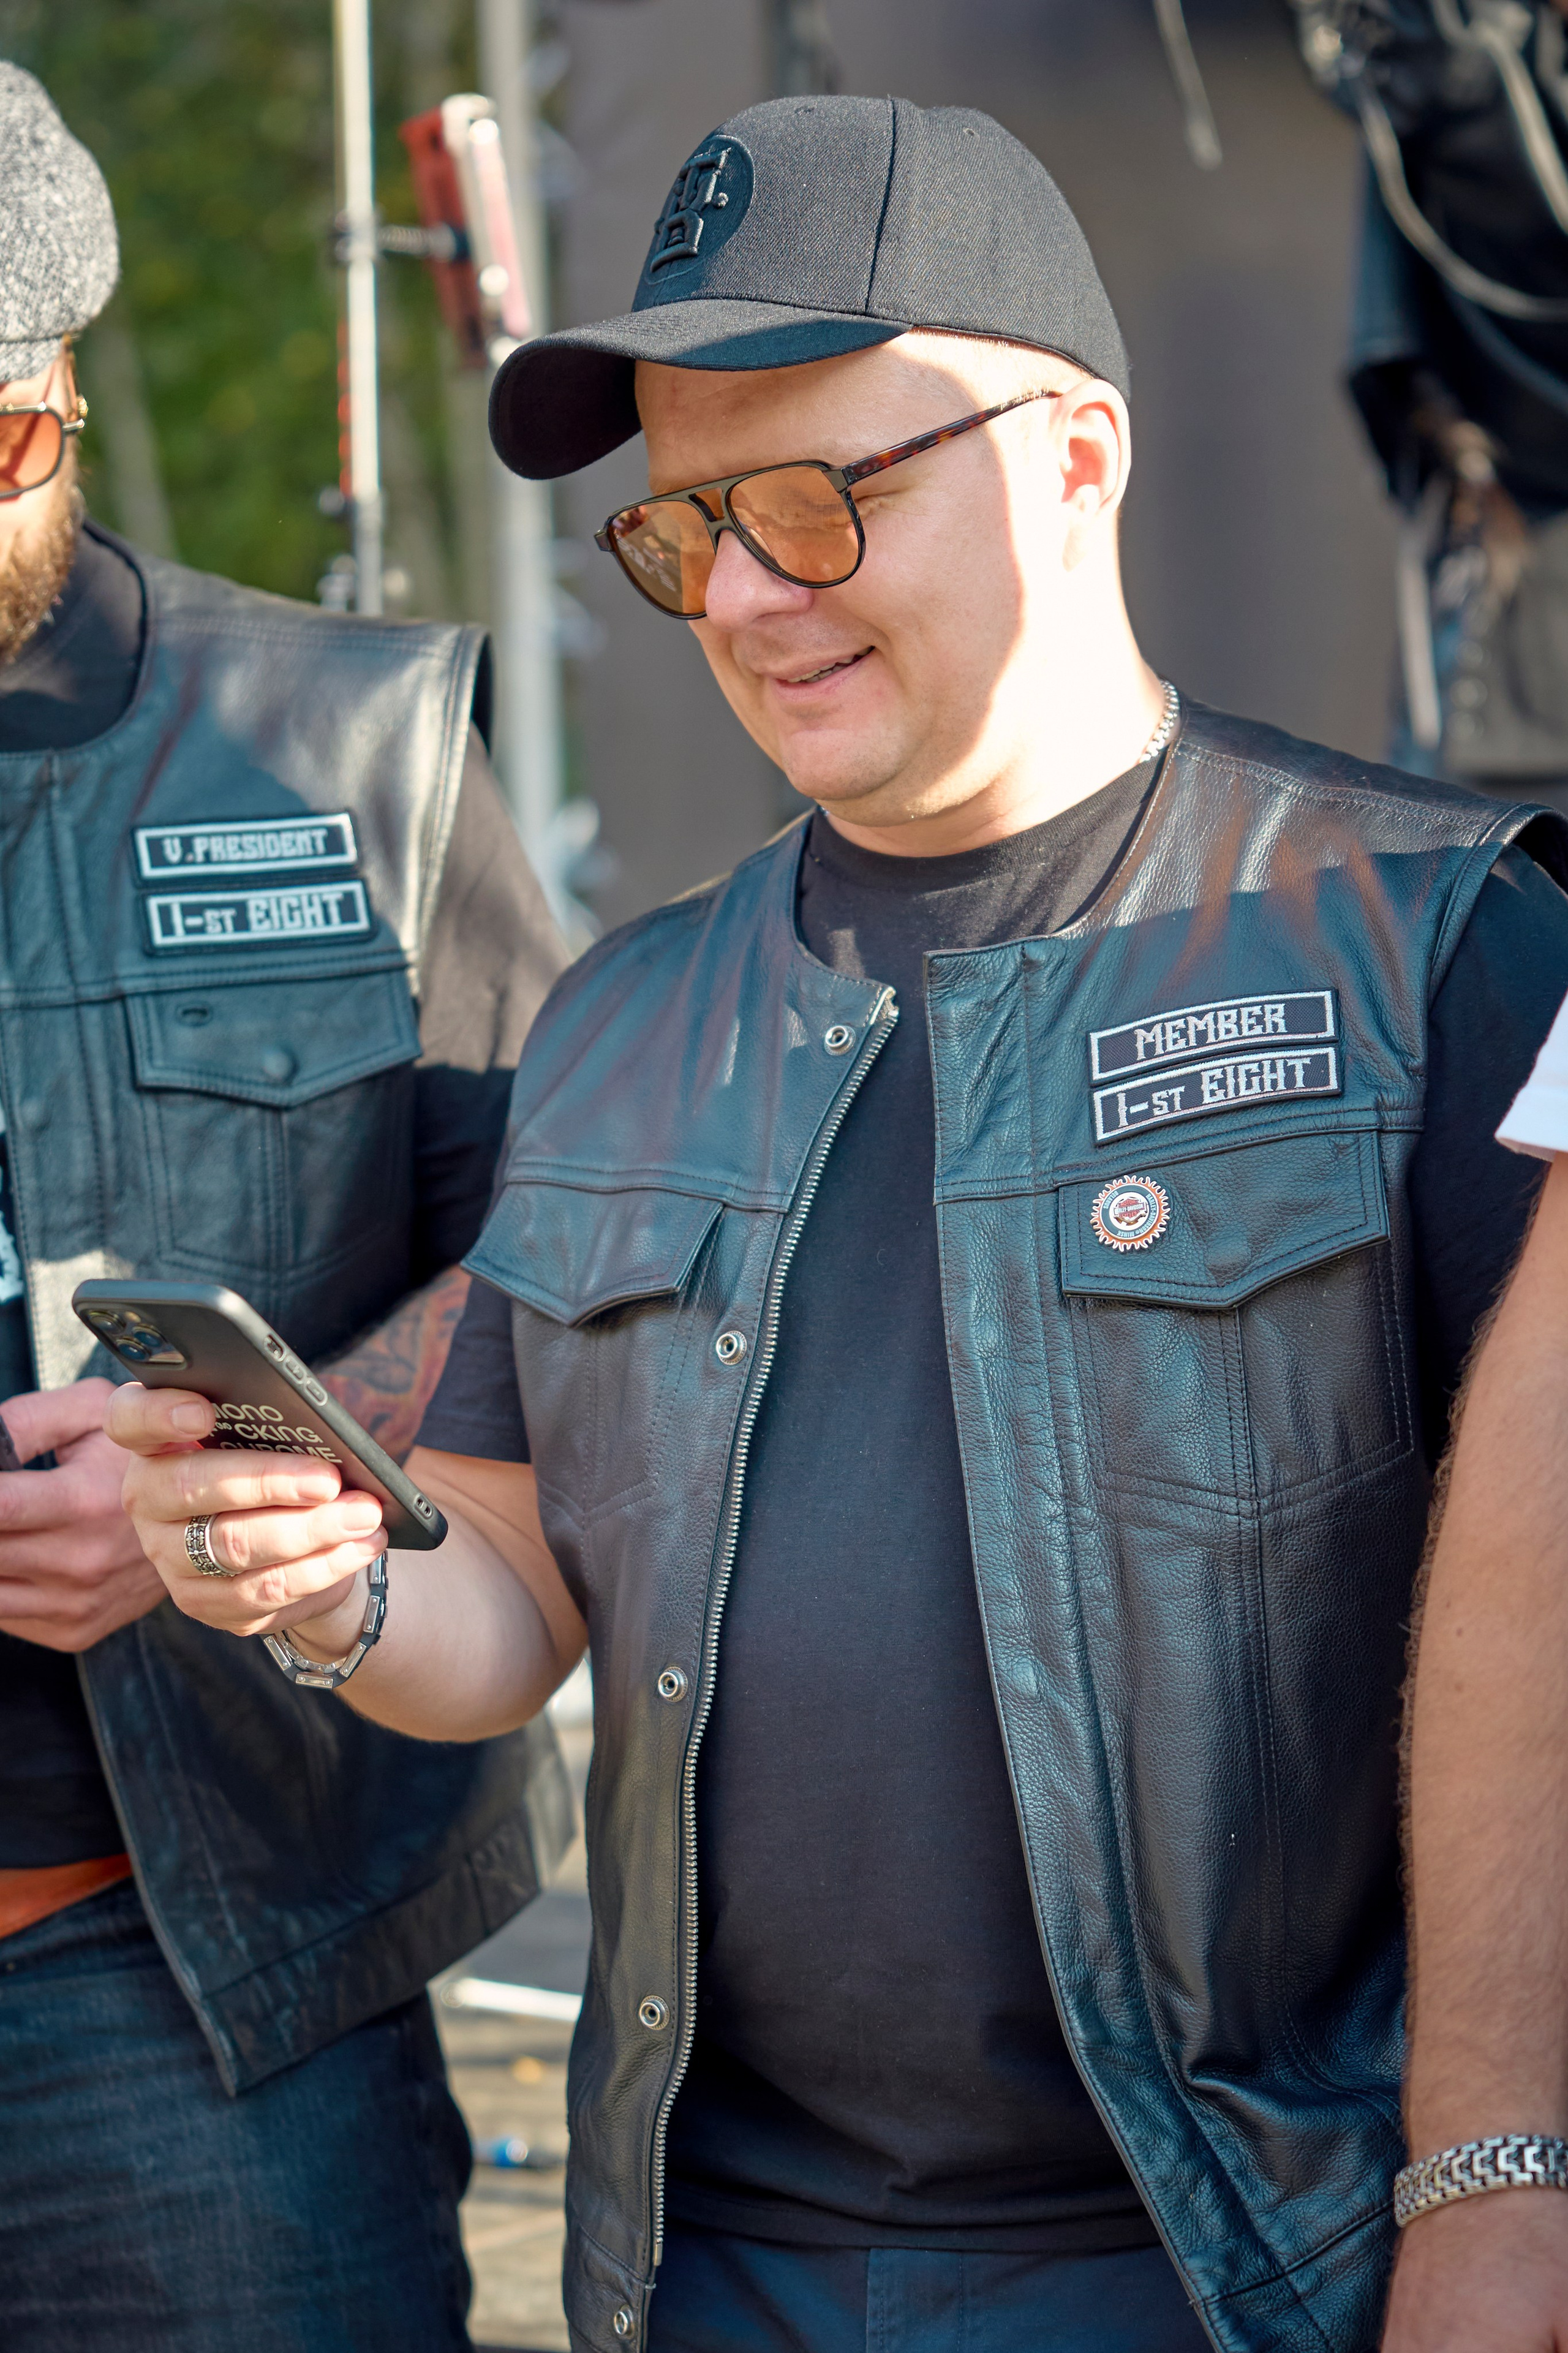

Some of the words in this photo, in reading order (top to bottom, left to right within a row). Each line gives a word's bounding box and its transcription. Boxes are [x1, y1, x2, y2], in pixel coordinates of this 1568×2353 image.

[162, 828, 328, 864] V.PRESIDENT
[247, 892, 344, 931] EIGHT
[1134, 1003, 1287, 1060] MEMBER
[1200, 1057, 1311, 1104] EIGHT
